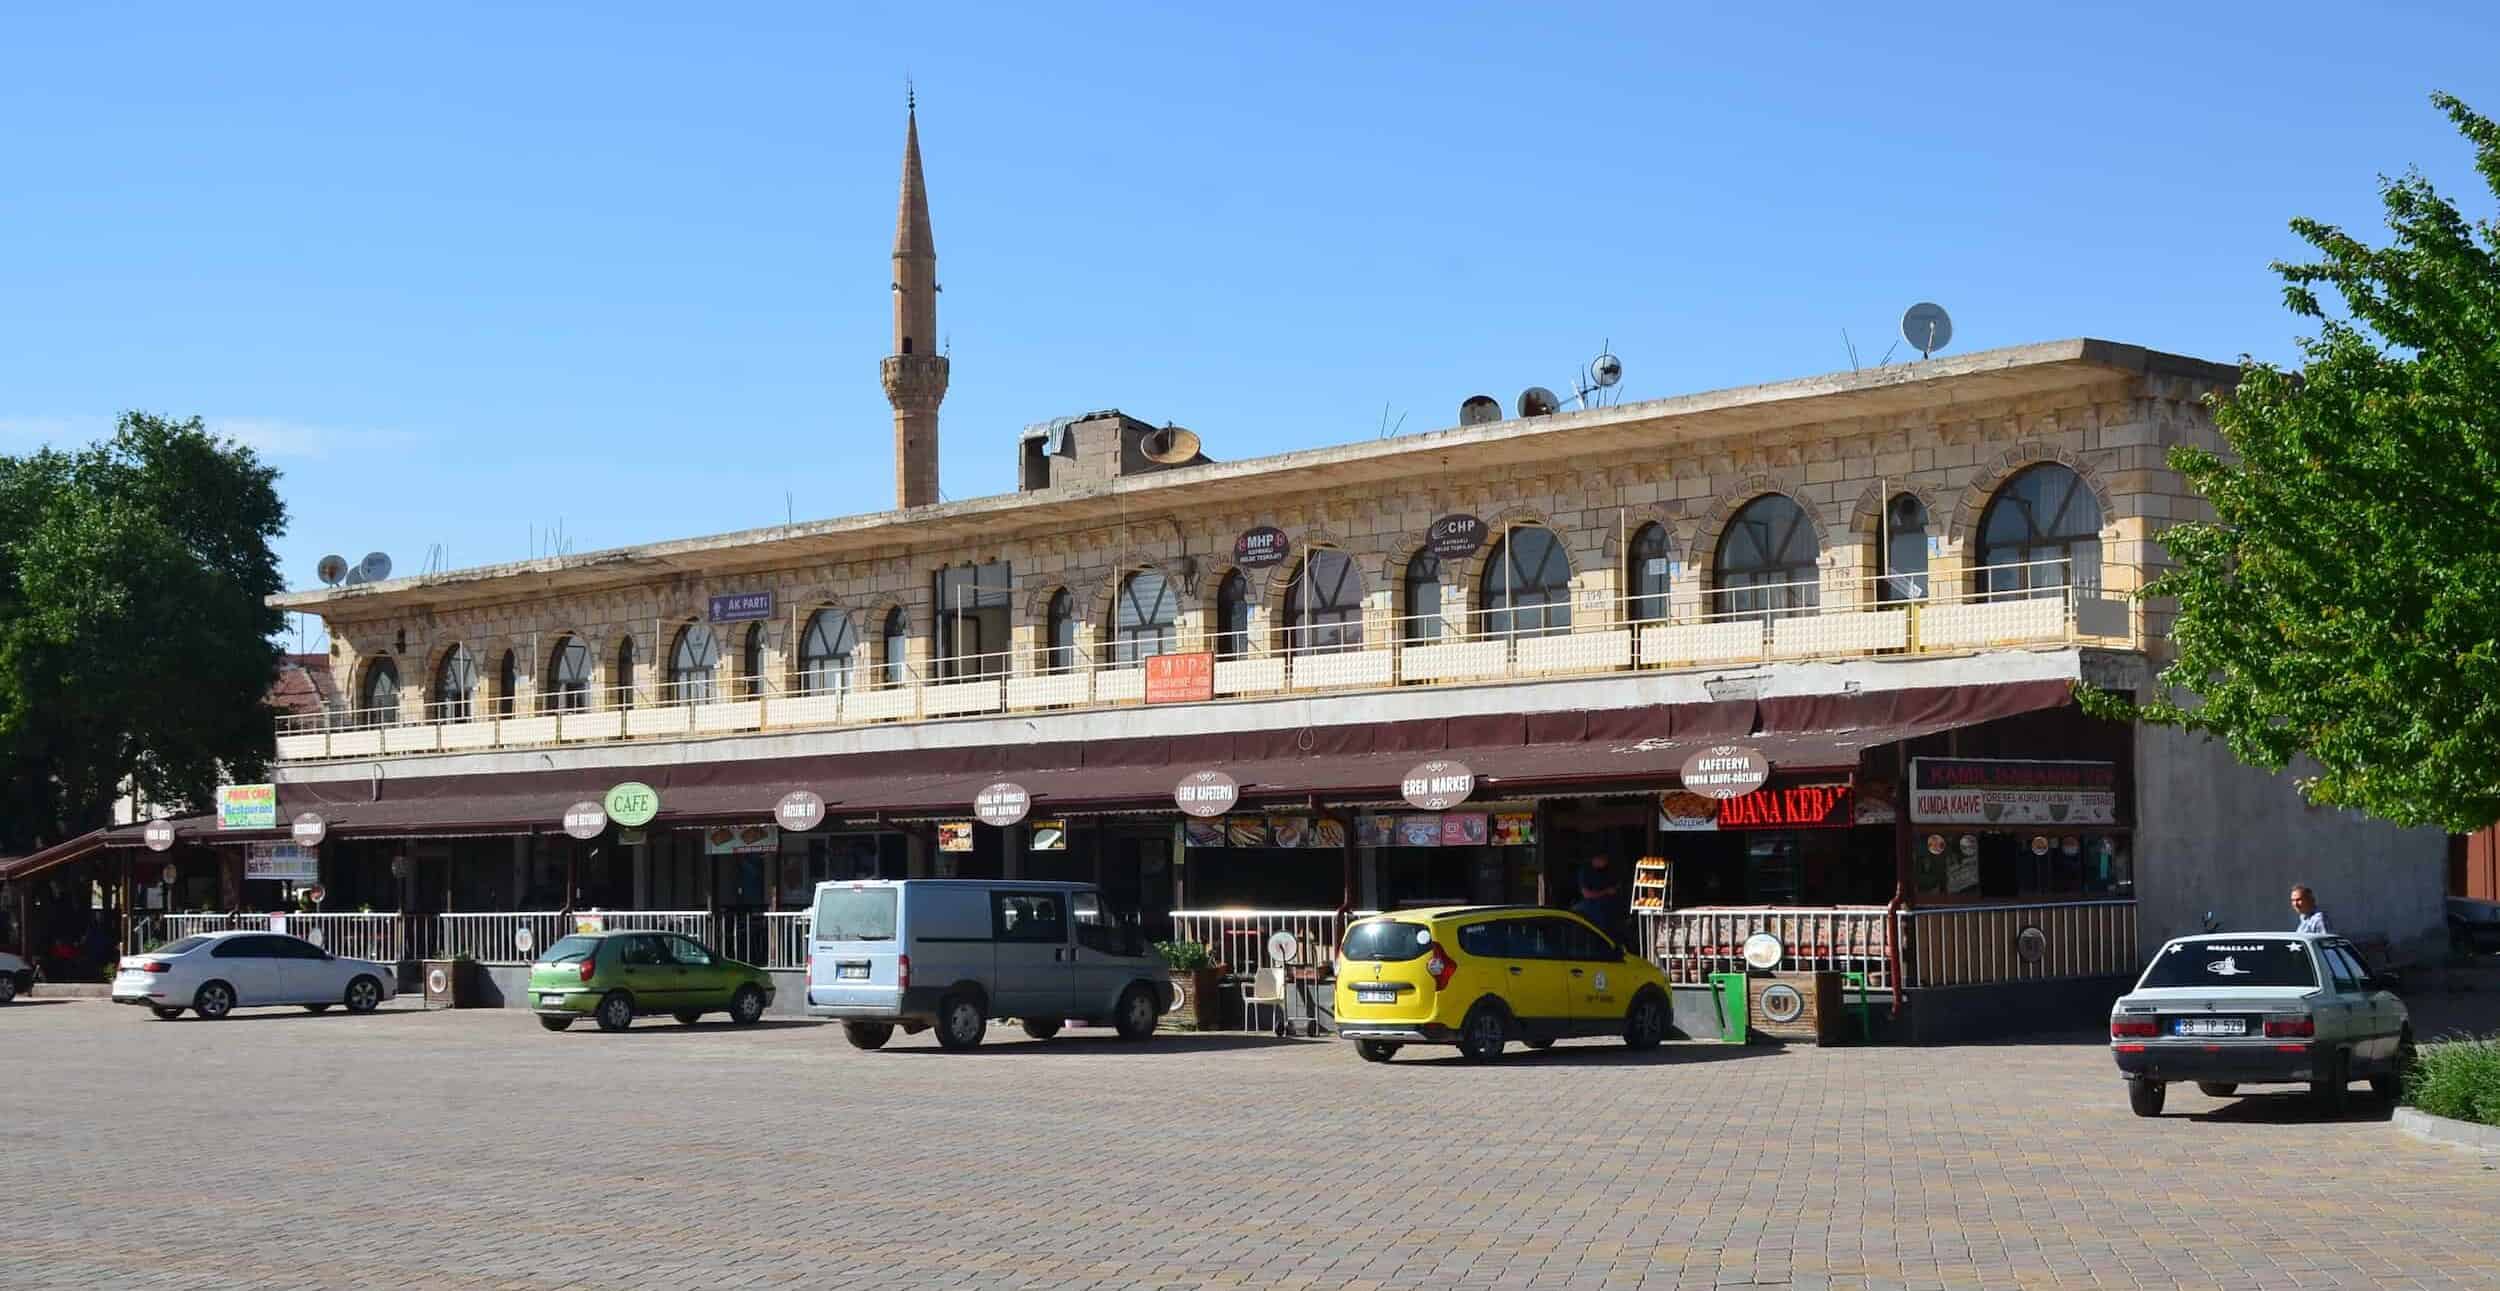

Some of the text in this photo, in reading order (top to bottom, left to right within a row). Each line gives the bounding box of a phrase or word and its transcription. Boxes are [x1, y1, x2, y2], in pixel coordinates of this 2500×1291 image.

[1448, 520, 1475, 533] CHP
[1248, 534, 1273, 548] MHP
[1698, 757, 1749, 771] KAFETERYA
[1403, 774, 1471, 796] EREN MARKET
[614, 794, 649, 812] CAFE
[1720, 790, 1783, 824] ADANA
[1920, 793, 1981, 814] KUMDA KAHVE
